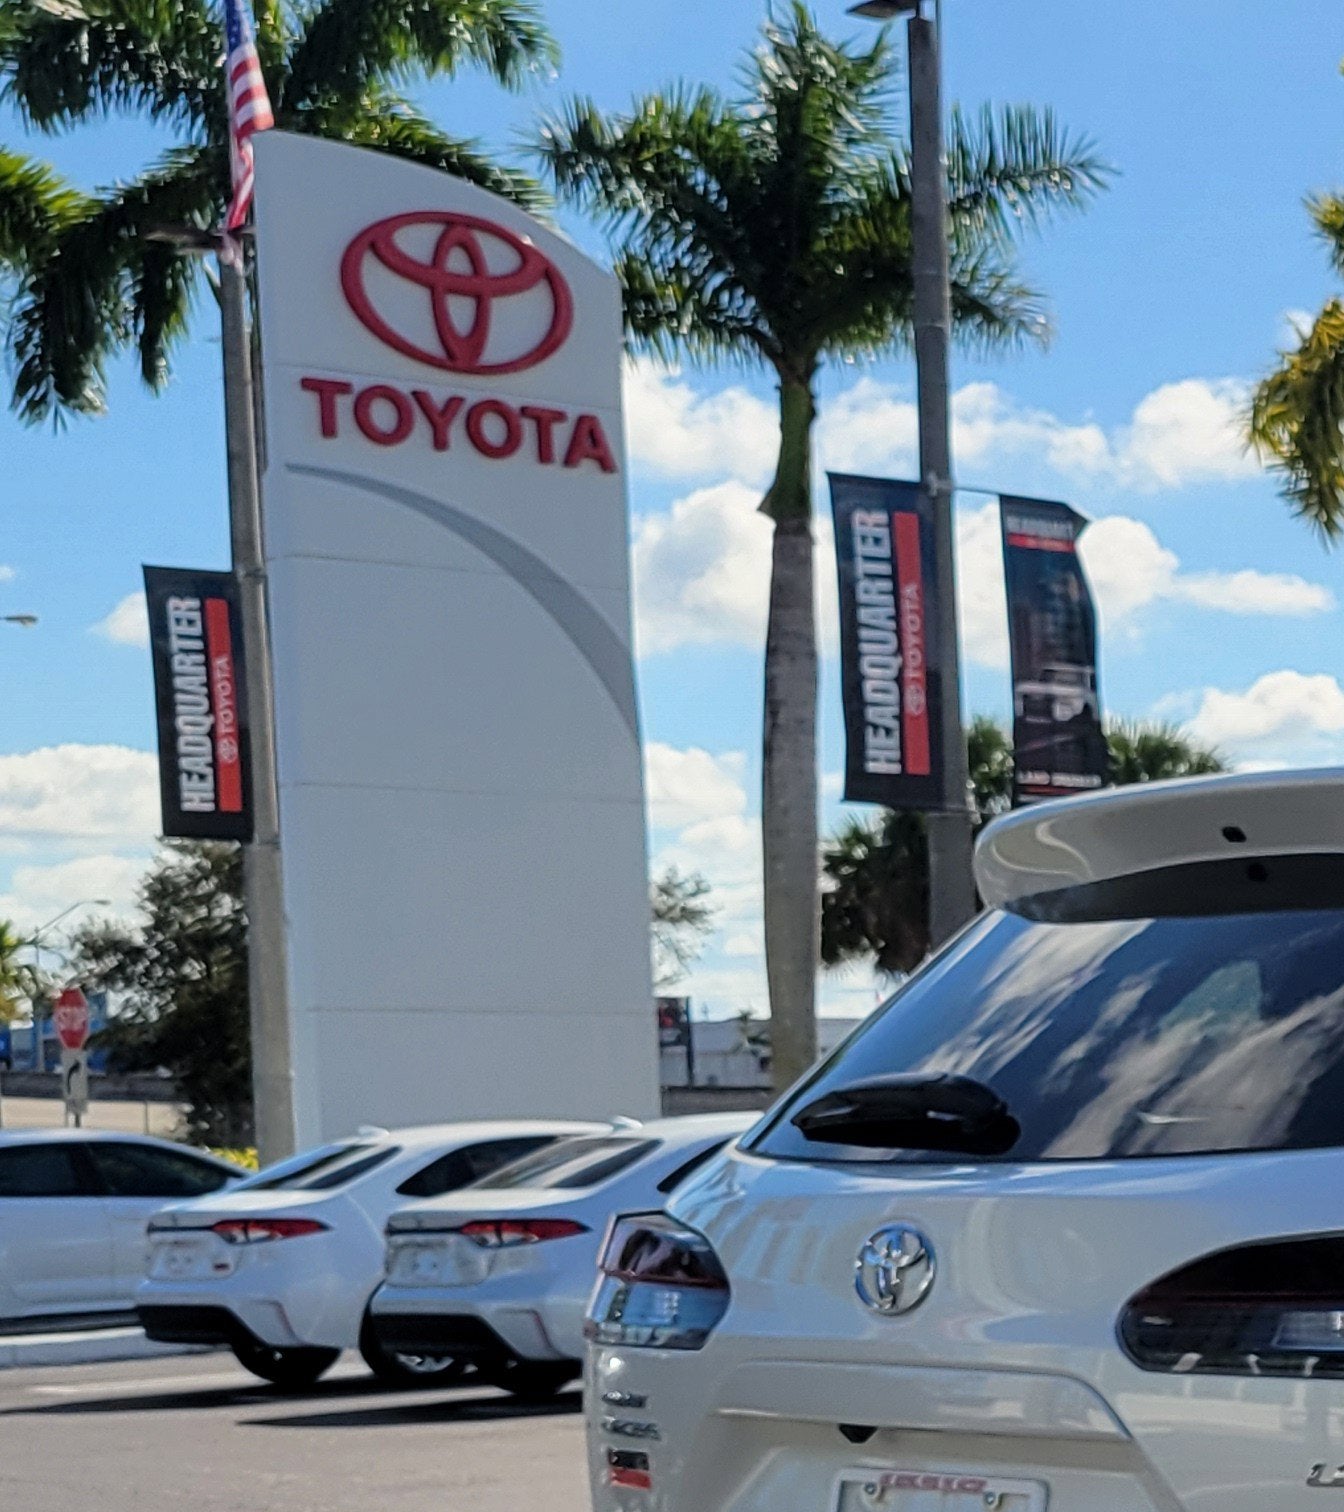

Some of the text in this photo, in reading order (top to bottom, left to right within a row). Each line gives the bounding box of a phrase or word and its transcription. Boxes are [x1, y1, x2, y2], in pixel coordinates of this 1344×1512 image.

[301, 378, 617, 474] TOYOTA
[852, 508, 902, 775] HEADQUARTER
[902, 582, 923, 678] TOYOTA
[167, 596, 215, 812] HEADQUARTER
[213, 656, 236, 734] TOYOTA
